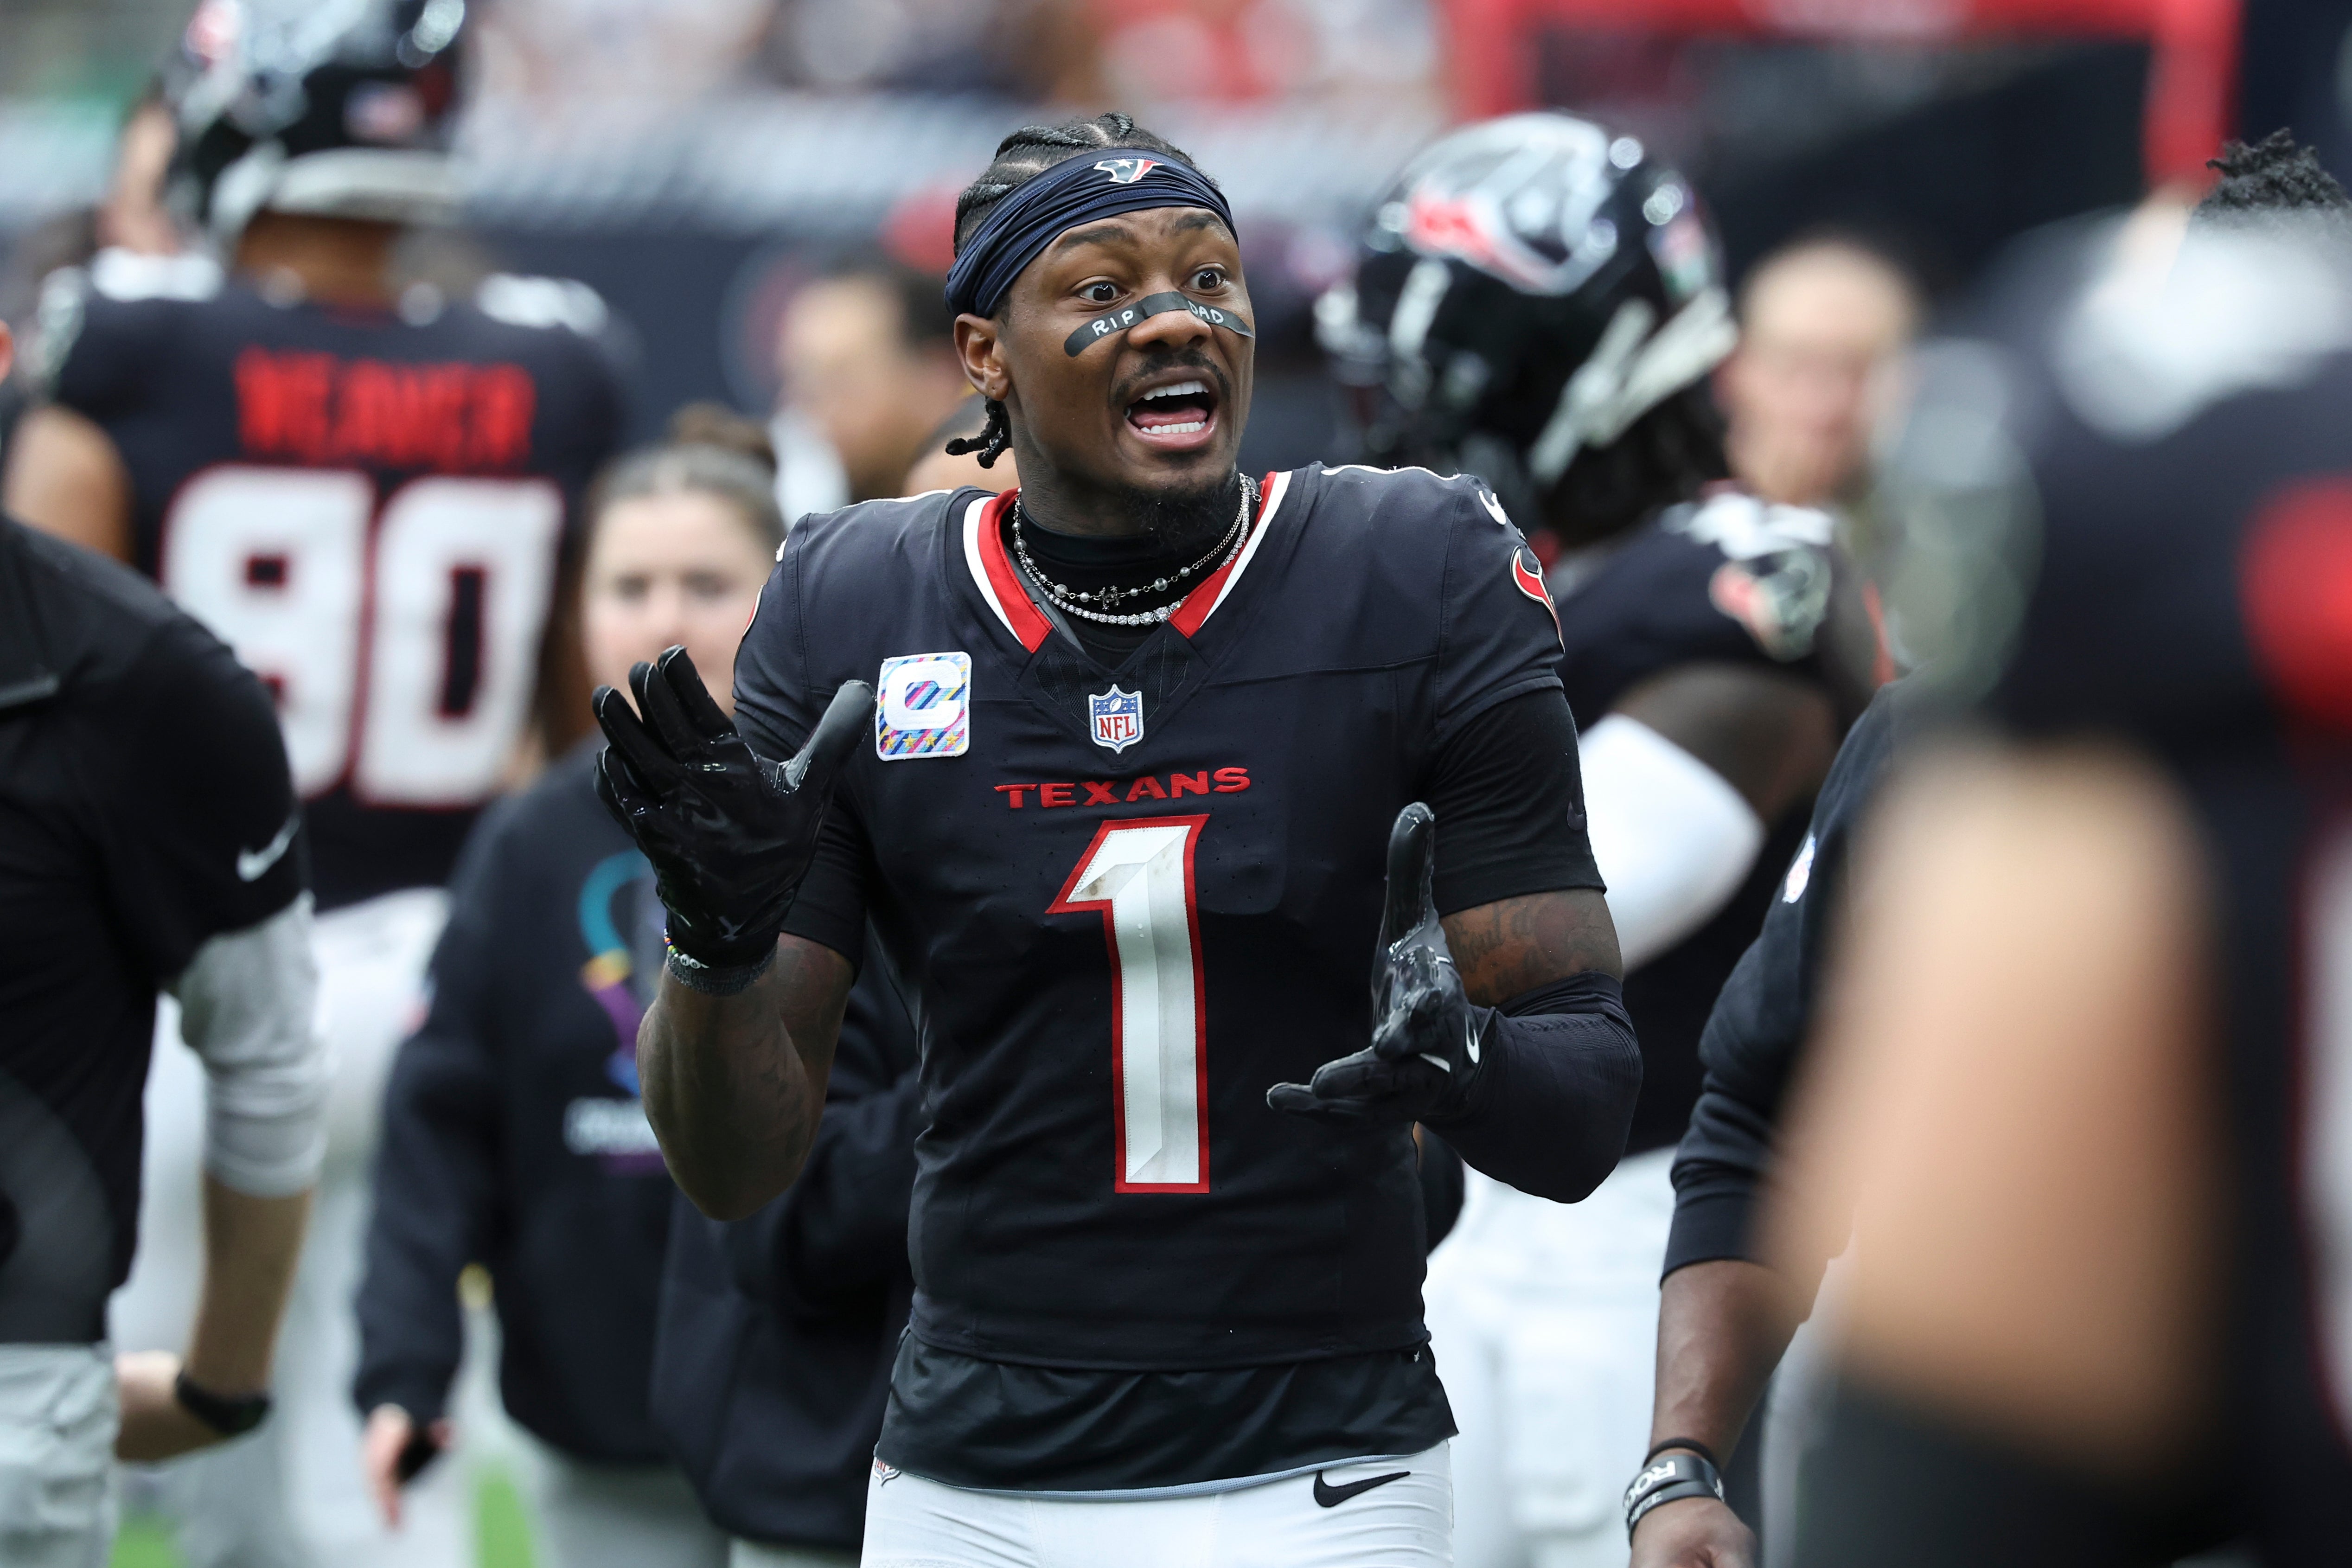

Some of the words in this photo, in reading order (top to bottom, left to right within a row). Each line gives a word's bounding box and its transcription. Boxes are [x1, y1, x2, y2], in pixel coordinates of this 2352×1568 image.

[1092, 310, 1134, 336] RIP
[1187, 300, 1224, 324] DAD
[159, 463, 566, 809] 90
[884, 661, 961, 731] C
[1099, 716, 1135, 741] NFL
[994, 767, 1251, 808] TEXANS
[1045, 814, 1210, 1193] 1
